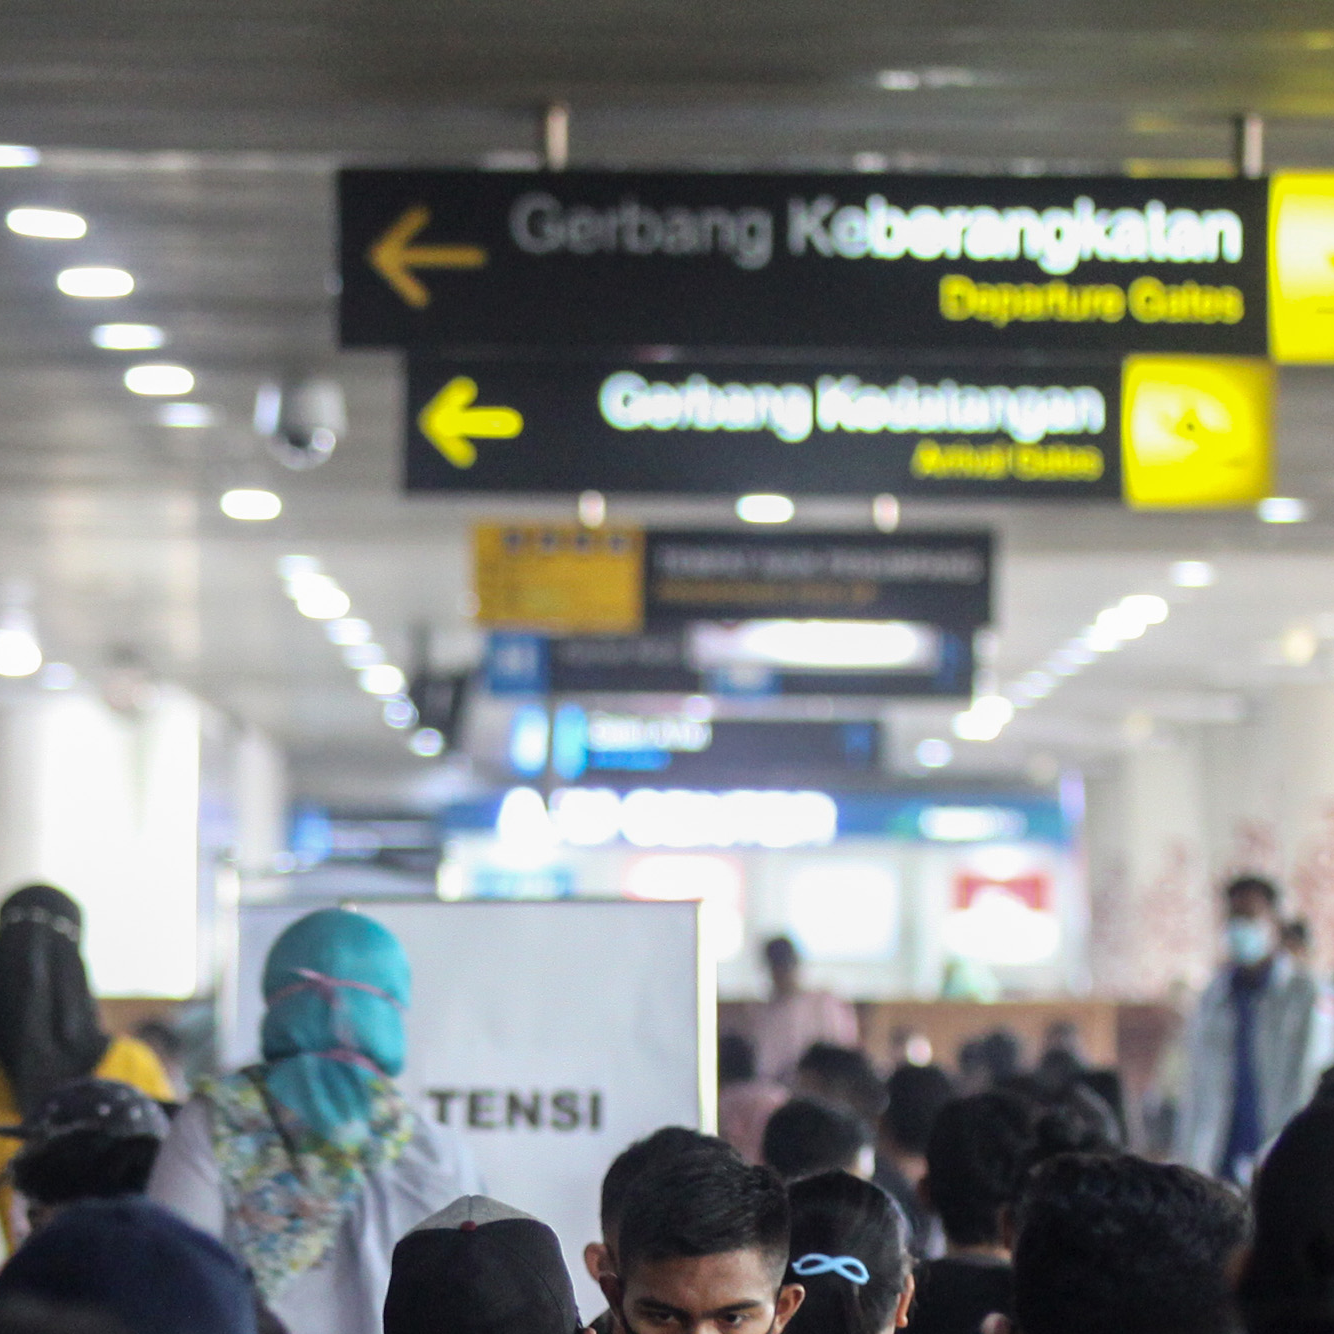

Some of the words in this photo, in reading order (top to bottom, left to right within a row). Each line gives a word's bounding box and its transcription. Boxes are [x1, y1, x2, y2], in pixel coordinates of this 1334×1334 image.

[508, 191, 774, 270] Gerbang
[786, 194, 1244, 275] Keberangkatan
[599, 371, 813, 443] Gerbang
[425, 1087, 604, 1133] TENSI
